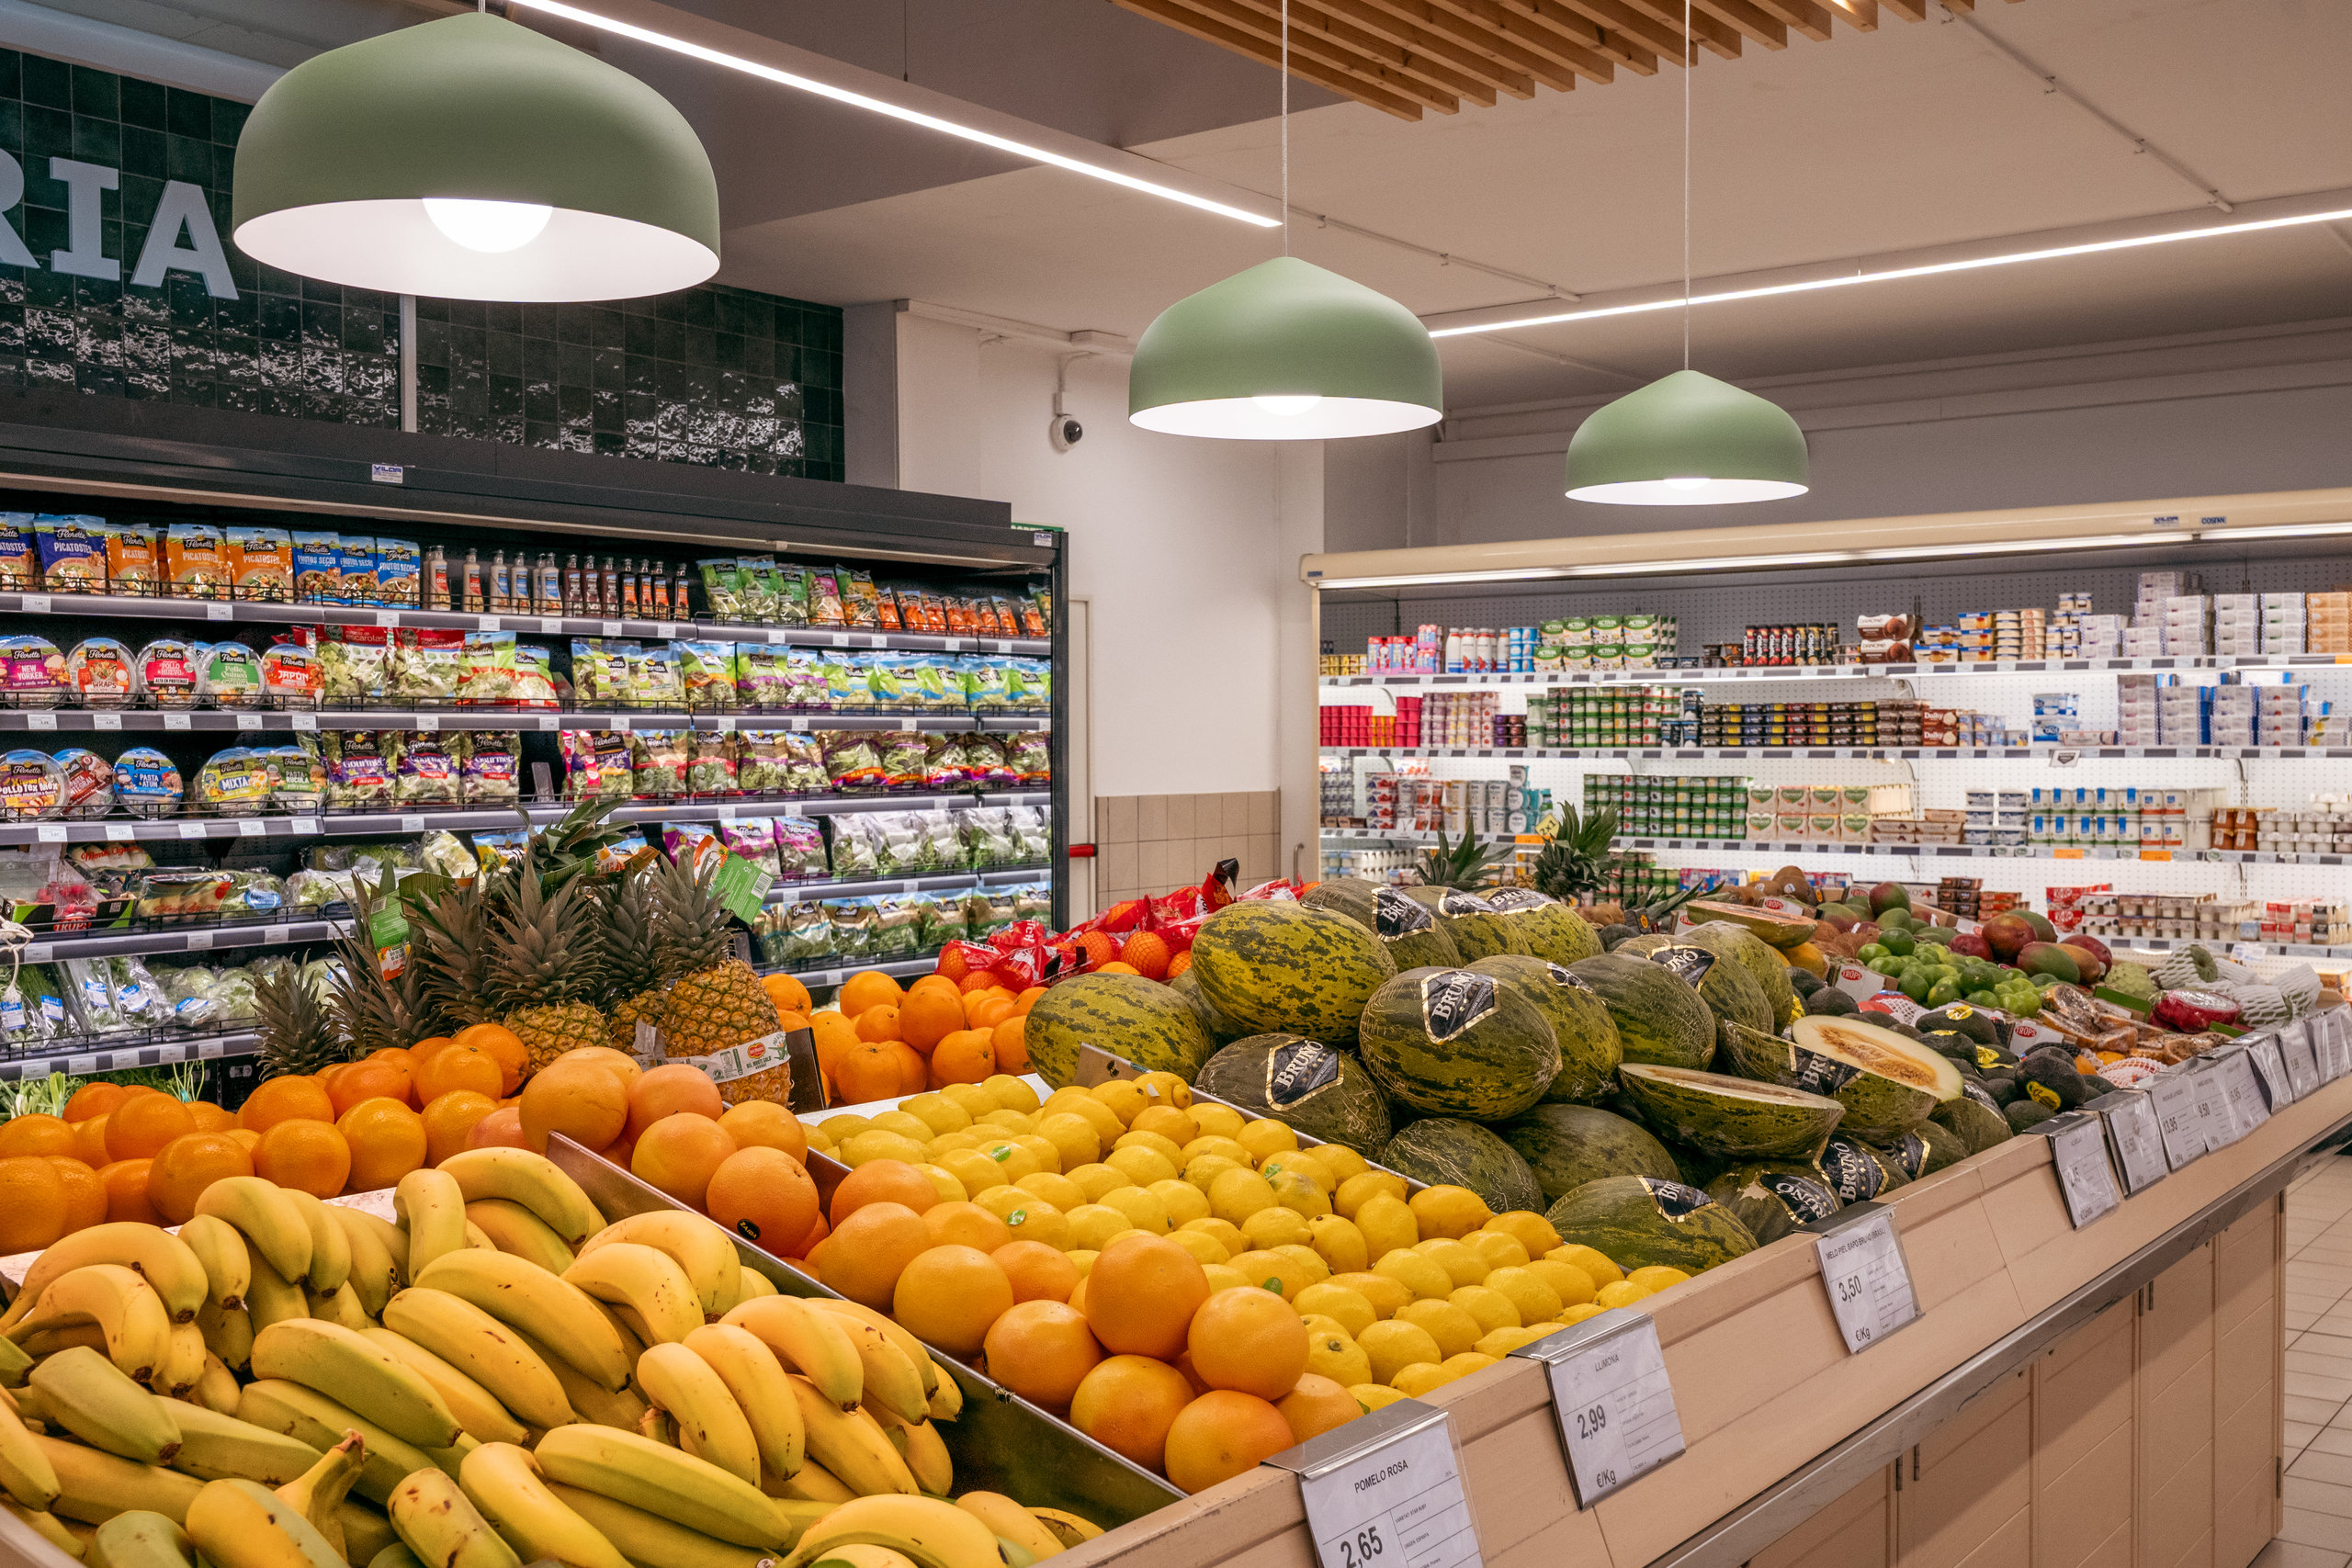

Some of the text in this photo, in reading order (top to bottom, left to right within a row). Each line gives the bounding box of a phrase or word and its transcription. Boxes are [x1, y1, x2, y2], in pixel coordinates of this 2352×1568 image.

[345, 635, 386, 643] escarolas
[13, 649, 41, 660] Florette
[89, 649, 116, 660] Florette
[156, 649, 182, 660] Florette
[17, 671, 43, 680] YORKER
[92, 681, 118, 689] WRAPS
[345, 740, 376, 751] Florette
[13, 764, 42, 774] Florette
[1841, 969, 1863, 980] TROPS
[2015, 1026, 2037, 1037] TROPS
[1838, 1275, 1862, 1303] 3,50
[1855, 1326, 1871, 1342] €/Kg
[1594, 1353, 1620, 1372] LLIMONA
[1577, 1404, 1607, 1440] 2,99
[1354, 1459, 1408, 1494] POMELO ROSA
[1596, 1469, 1617, 1488] €/Kg
[1340, 1525, 1384, 1568] 2,65
